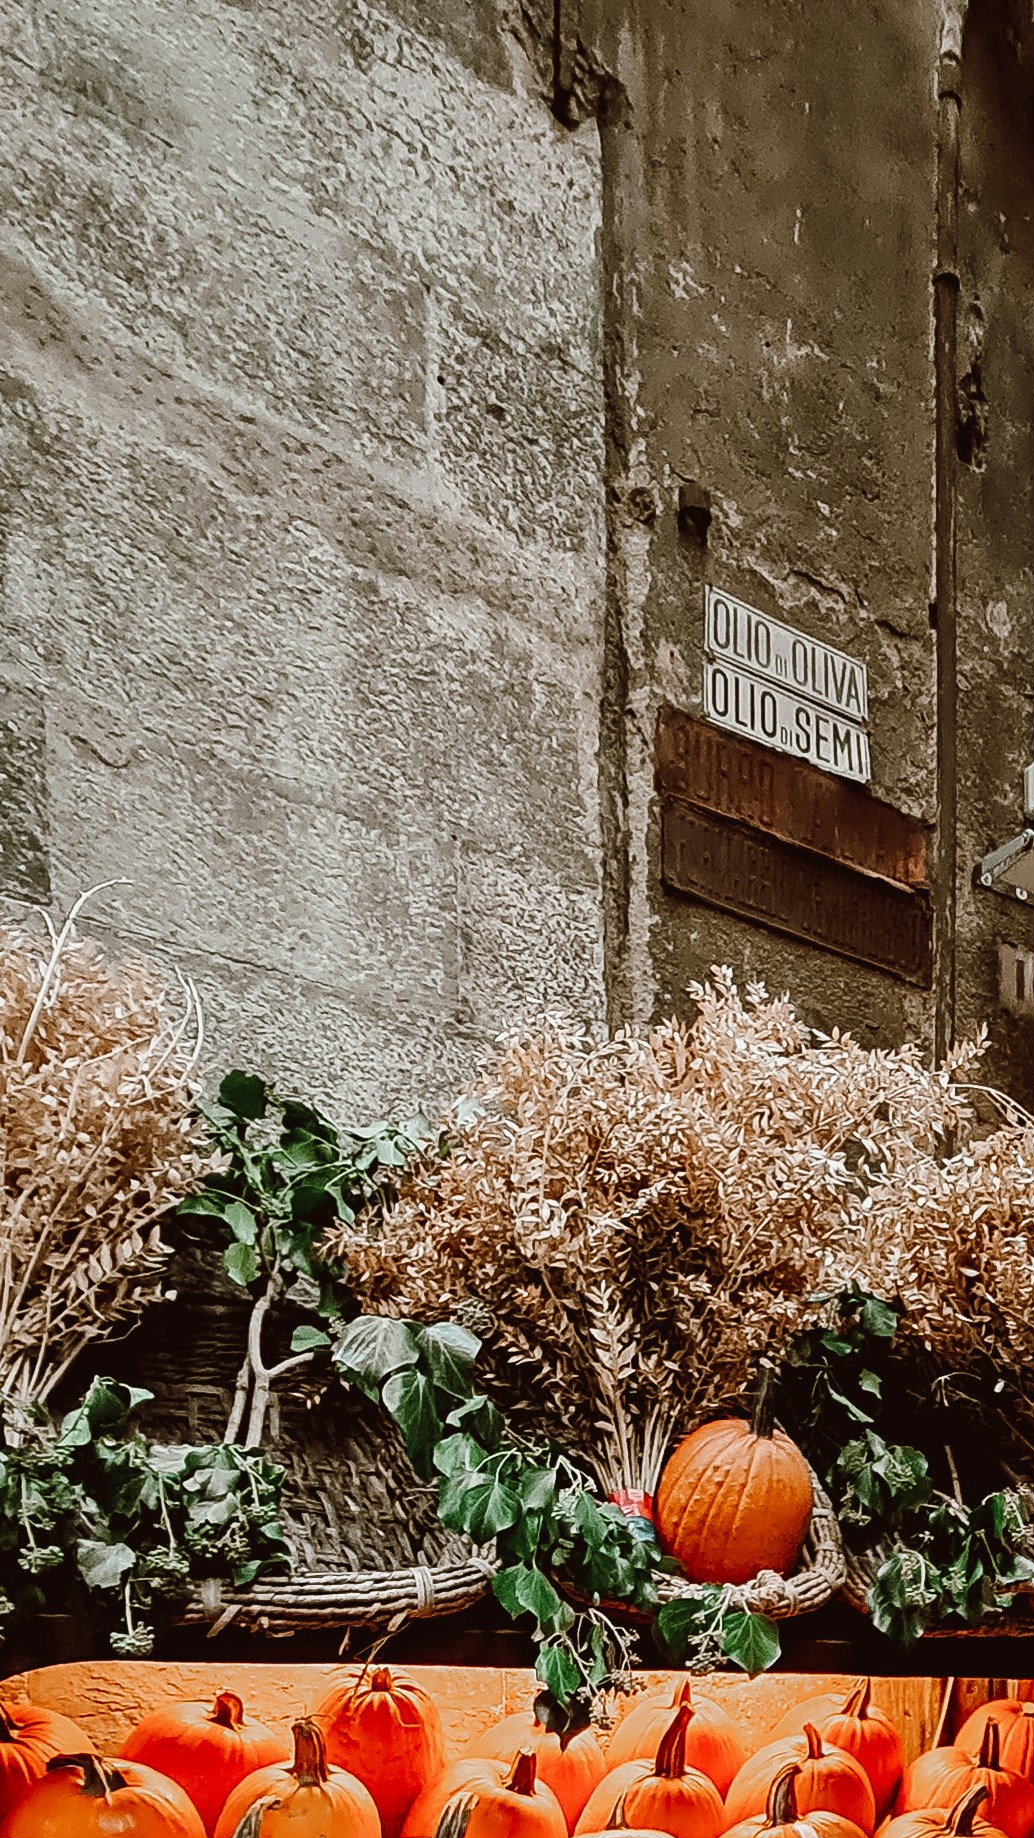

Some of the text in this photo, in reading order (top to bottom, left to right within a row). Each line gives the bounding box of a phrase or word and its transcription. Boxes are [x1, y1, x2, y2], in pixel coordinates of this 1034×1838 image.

[712, 597, 863, 709] OLIO DI OLIVA
[710, 667, 777, 740] OLIO
[780, 722, 795, 748] DI
[795, 707, 866, 777] SEMI
